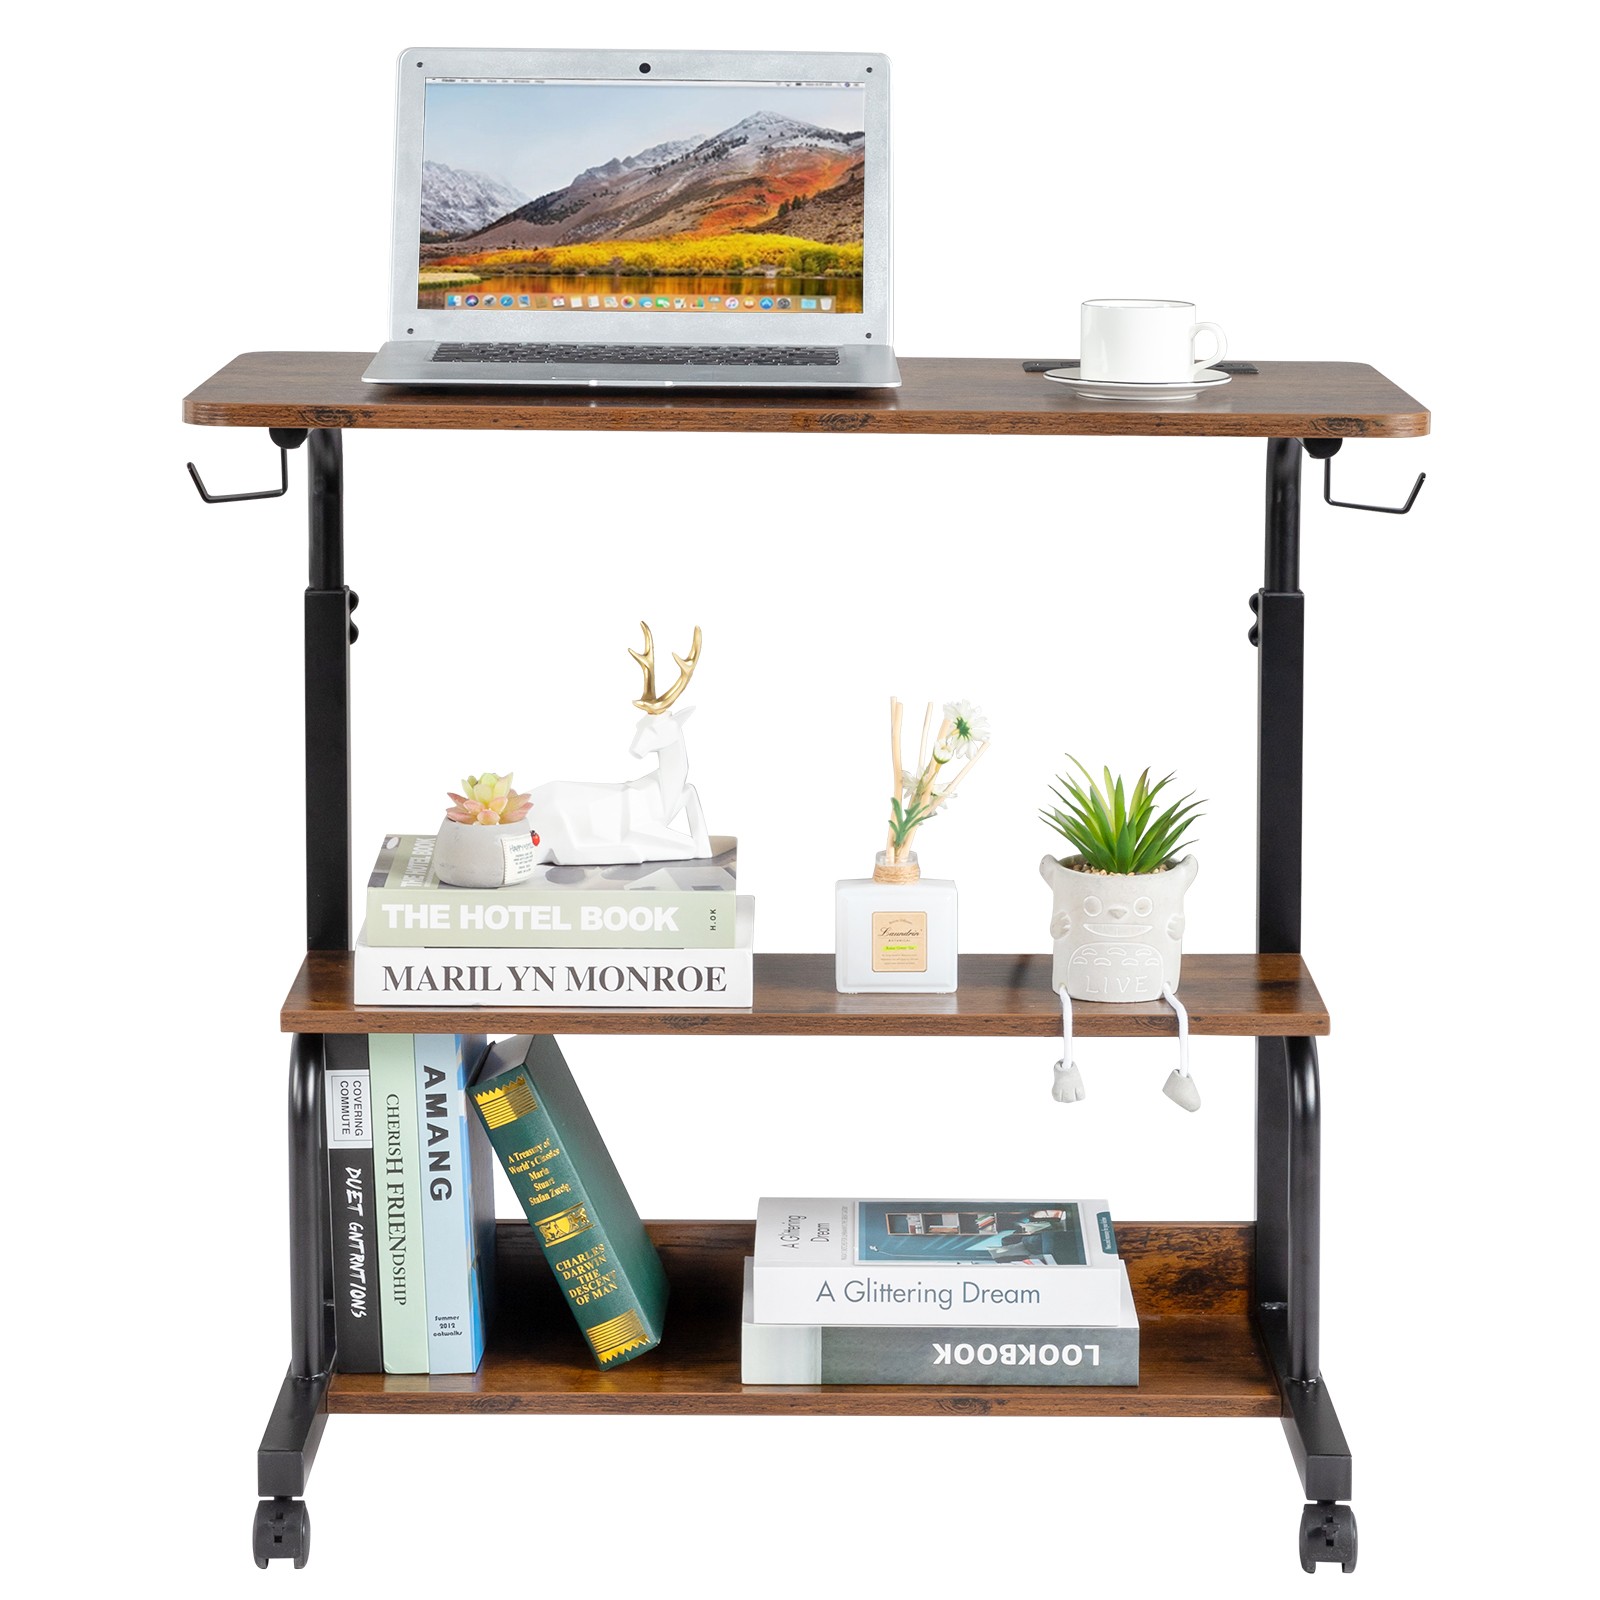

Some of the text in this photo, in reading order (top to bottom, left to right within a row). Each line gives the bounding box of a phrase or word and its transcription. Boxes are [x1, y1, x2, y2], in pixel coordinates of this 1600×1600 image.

[400, 837, 437, 887] THE HOTEL BOOK
[381, 903, 680, 932] THE HOTEL BOOK
[709, 908, 717, 931] H.OK
[565, 965, 728, 992] MONROE
[1085, 975, 1148, 993] LIVE
[340, 1080, 351, 1135] COMMUTE
[352, 1080, 364, 1137] COVERING
[423, 1065, 452, 1202] AMANG
[507, 1137, 551, 1164] A Treasury of
[508, 1160, 536, 1175] World's
[345, 1165, 364, 1217] DUET
[386, 1093, 408, 1307] CHERISH FRIENDSHIP
[777, 1214, 807, 1242] Glittering
[810, 1222, 830, 1243] Dream
[555, 1243, 605, 1272] CHARLES
[562, 1254, 607, 1280] DARWIN
[568, 1269, 616, 1298] DESCENT
[576, 1268, 600, 1285] THE
[575, 1281, 618, 1306] OF MAN
[815, 1277, 1041, 1311] A Glittering Dream
[932, 1343, 1101, 1366] LOOKBOOK
